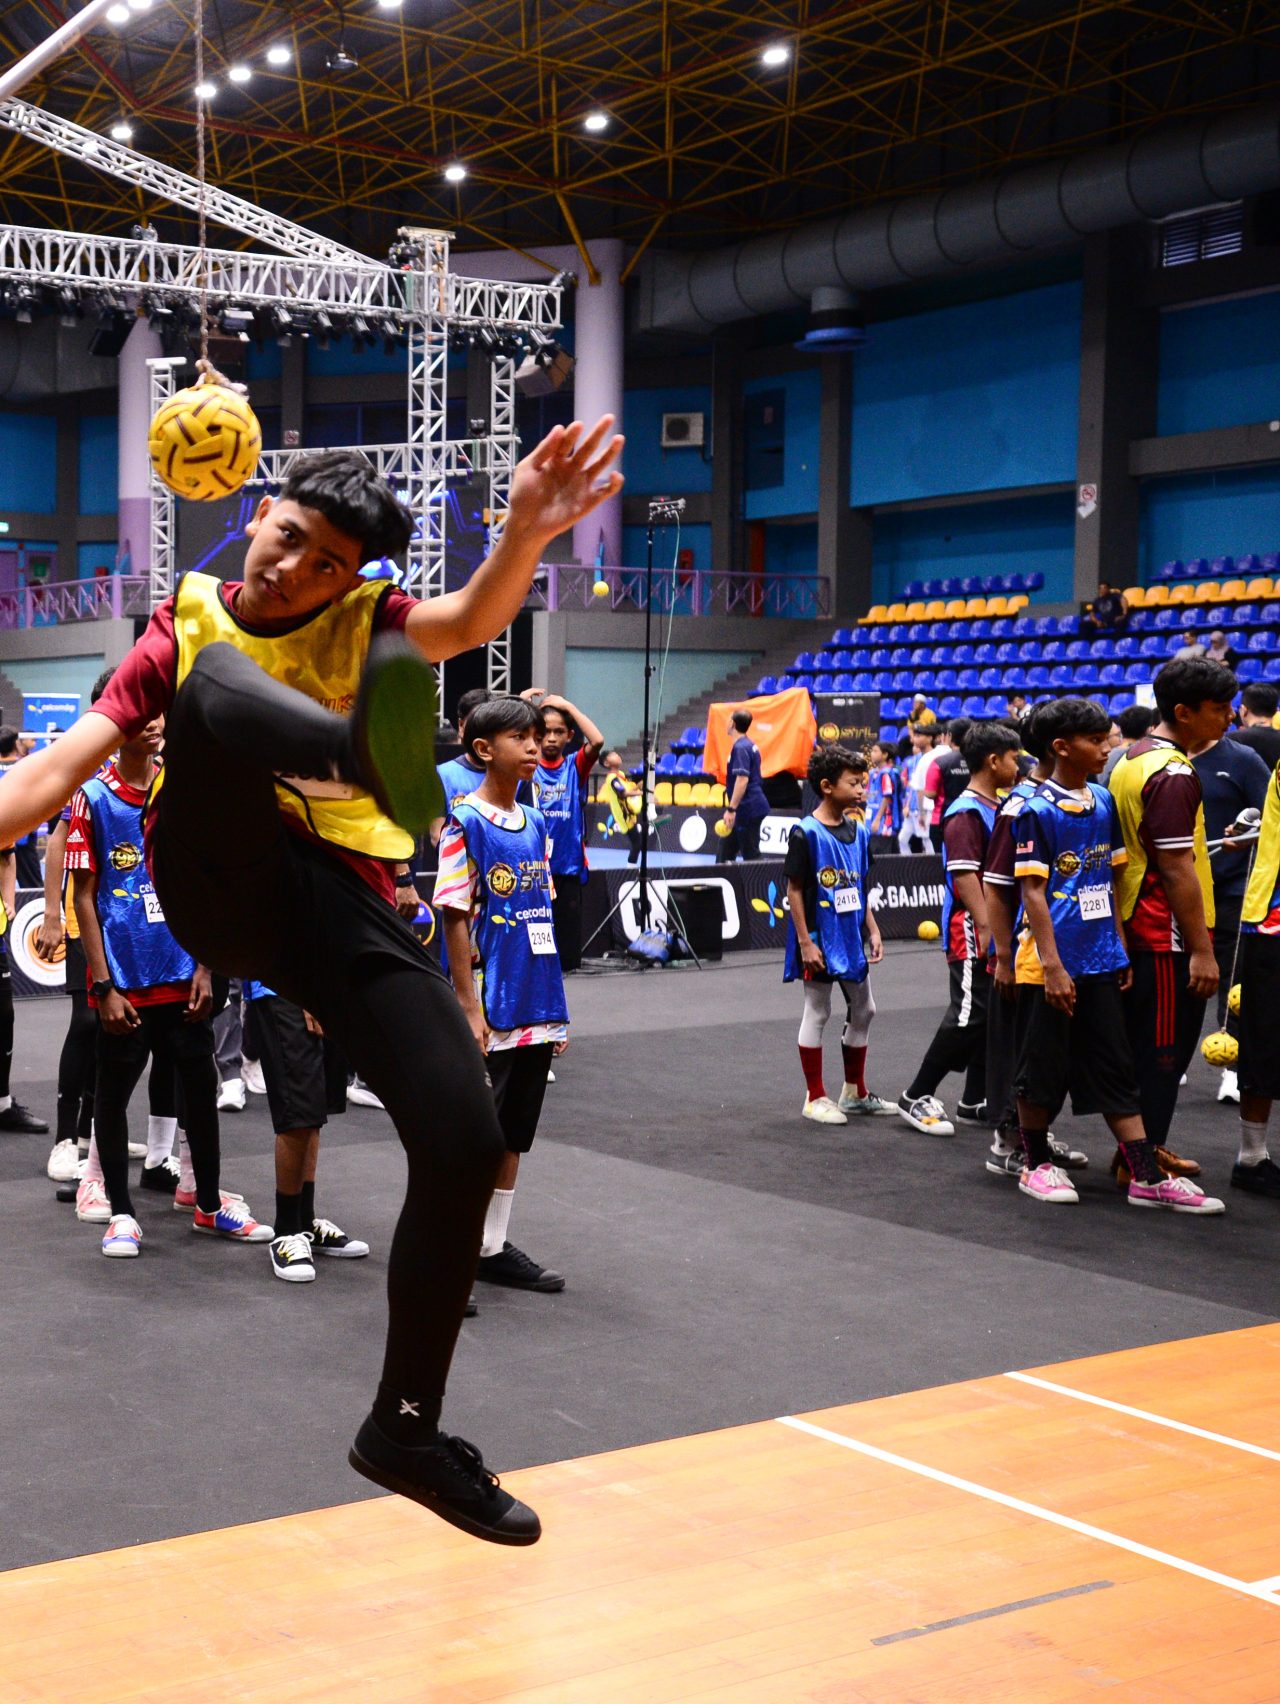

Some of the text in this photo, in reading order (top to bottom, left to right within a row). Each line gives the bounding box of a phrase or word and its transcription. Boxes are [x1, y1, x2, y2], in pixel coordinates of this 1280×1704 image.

[836, 893, 857, 906] 2418
[1083, 898, 1106, 912] 2281
[531, 932, 552, 945] 2394
